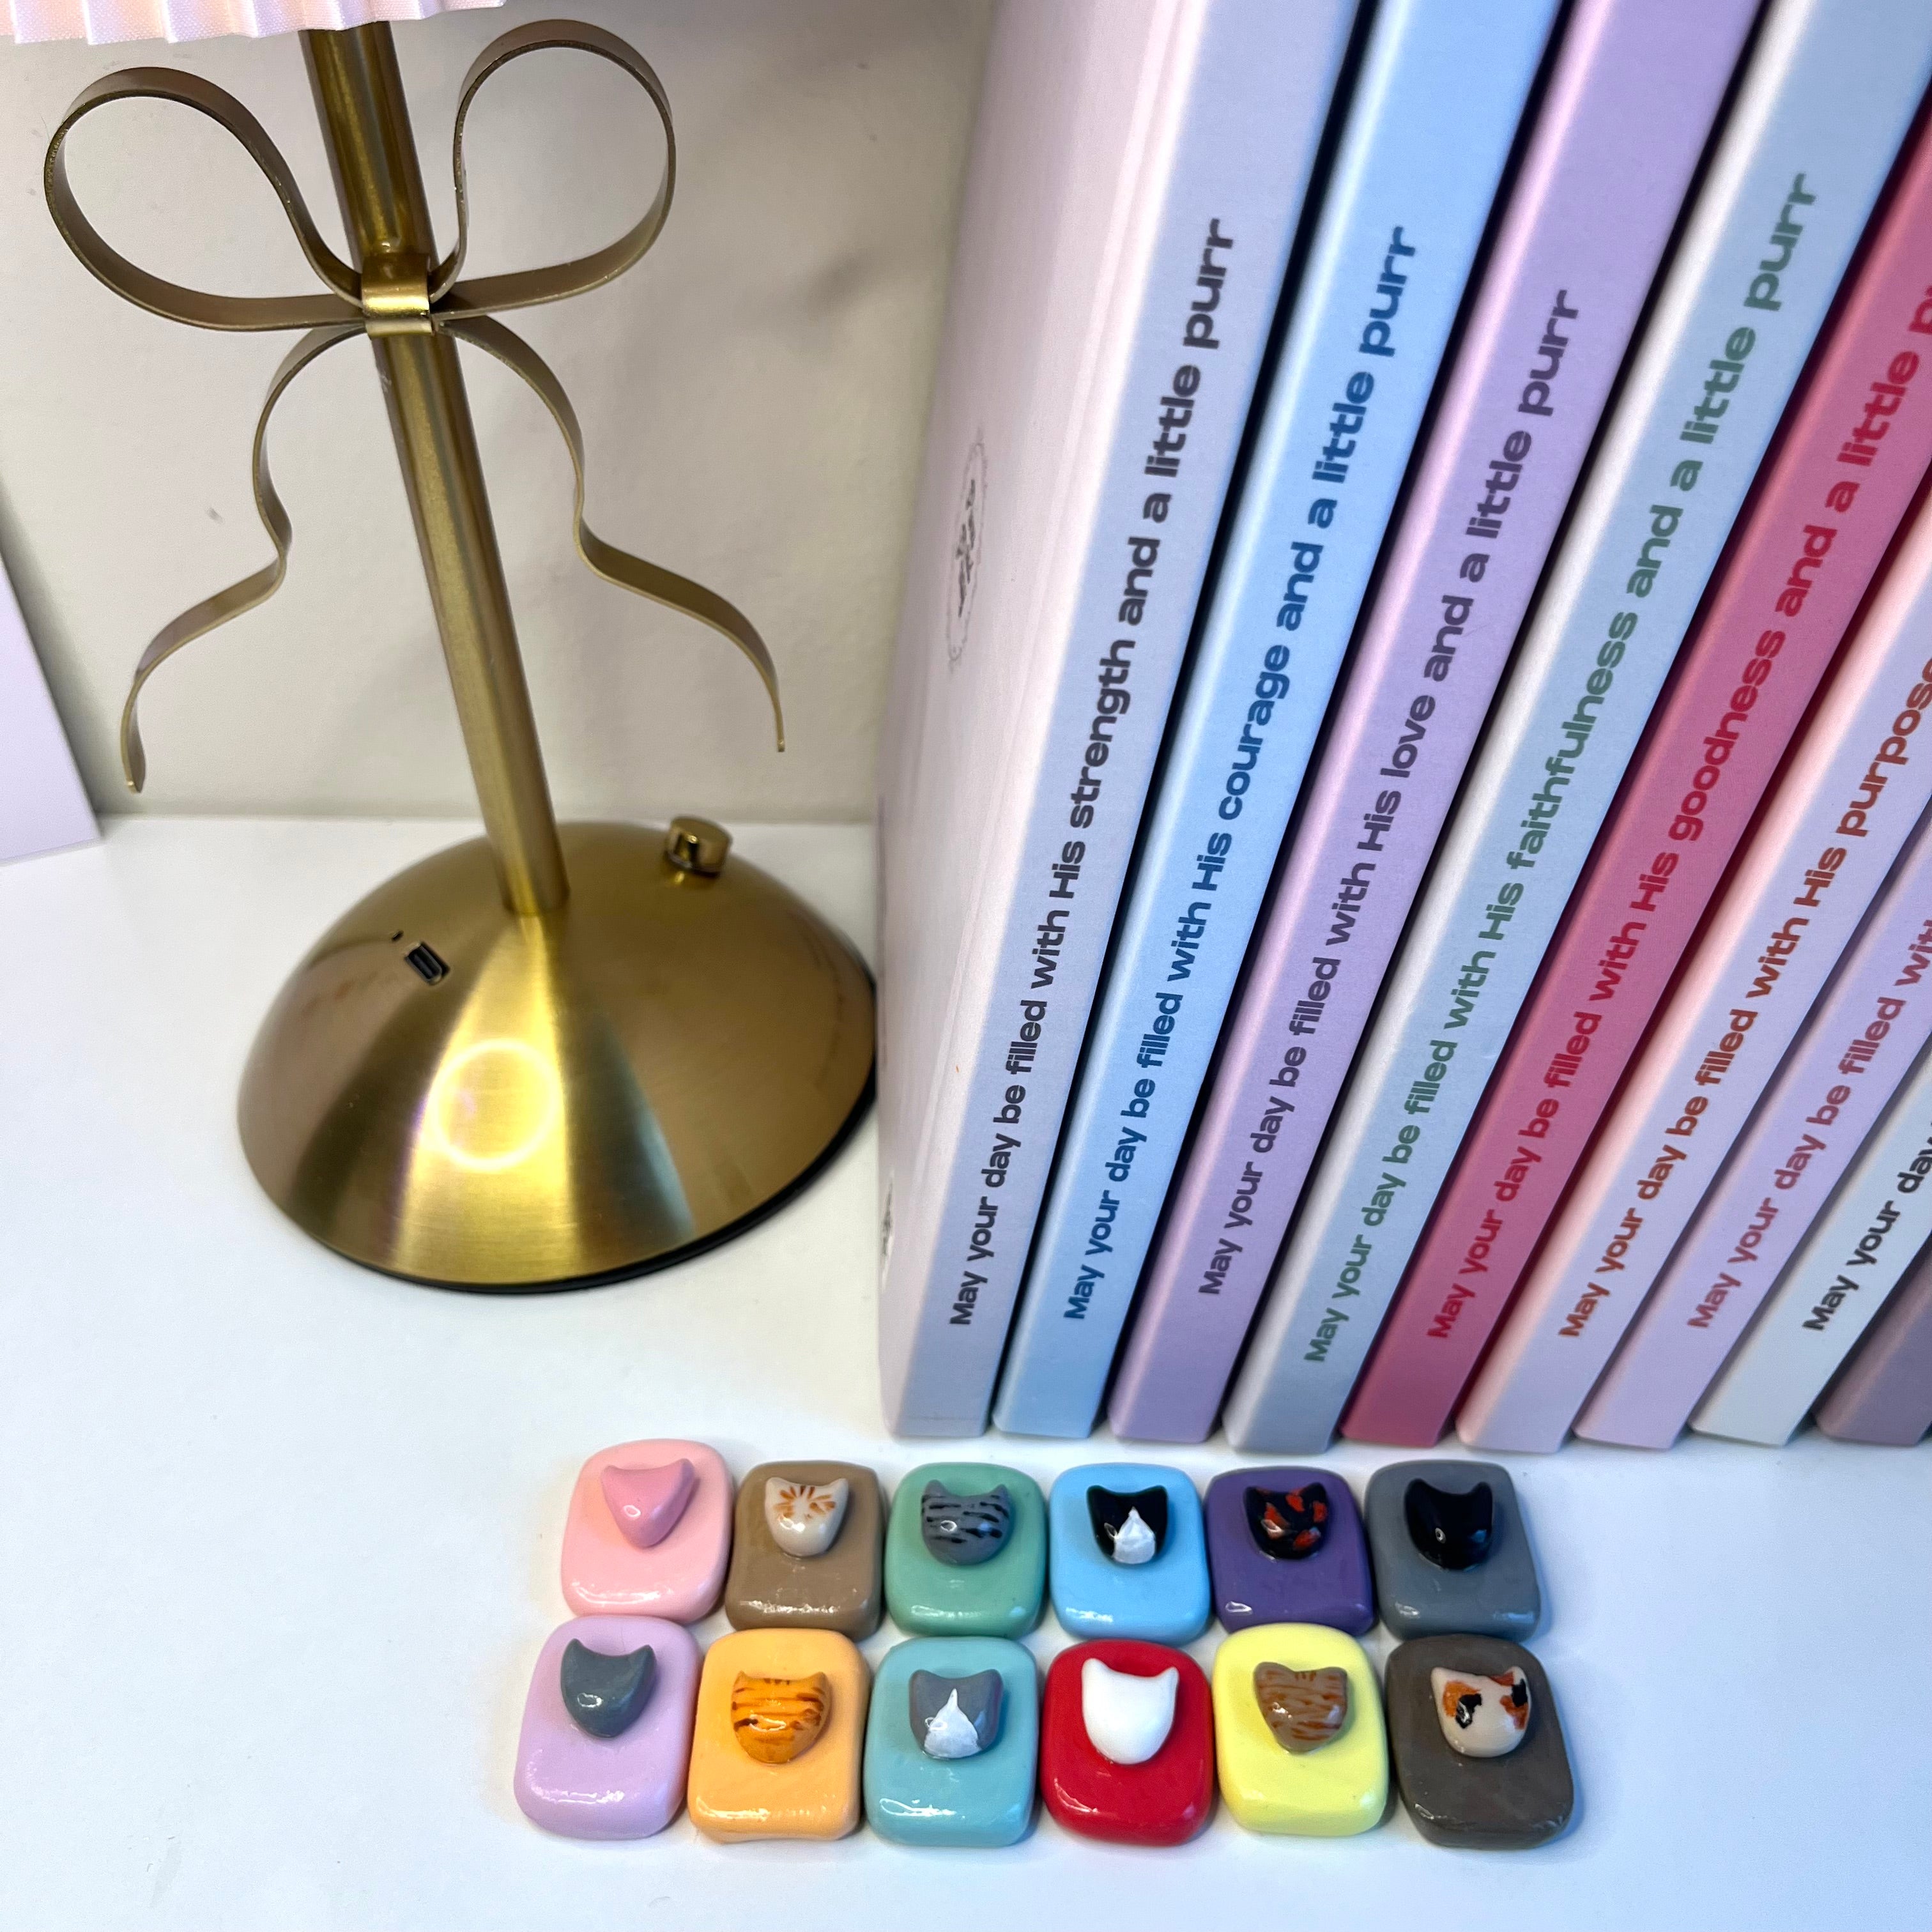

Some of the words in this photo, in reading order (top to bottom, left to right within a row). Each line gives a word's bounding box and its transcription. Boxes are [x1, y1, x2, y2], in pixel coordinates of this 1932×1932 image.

[1744, 172, 1816, 312] purr
[1183, 218, 1234, 349] purr
[1358, 226, 1416, 357] purr
[1517, 289, 1579, 417] purr
[1679, 326, 1756, 445] little
[1144, 364, 1201, 478] little
[1312, 371, 1375, 484] little
[1836, 351, 1920, 467] little
[1142, 493, 1172, 523] a
[1307, 498, 1338, 529] a
[1465, 430, 1532, 539] little
[1669, 459, 1703, 492] a
[1825, 480, 1860, 513] a
[1118, 536, 1161, 626] and
[1276, 541, 1324, 631] and
[1459, 553, 1490, 583] a
[1626, 504, 1683, 598] and
[1774, 524, 1838, 617] and
[1423, 594, 1475, 682] and
[1070, 640, 1136, 829] strength
[1218, 645, 1291, 820] courage
[1379, 694, 1436, 778] love
[1506, 611, 1638, 870] faithfulness
[1668, 629, 1786, 841] goodness
[1356, 790, 1402, 852] His
[1048, 841, 1086, 899] His
[1192, 832, 1232, 891] His
[1629, 852, 1679, 912] His
[1167, 901, 1212, 982] with
[1325, 862, 1376, 946] with
[1478, 882, 1524, 940] His
[1031, 910, 1070, 989] with
[1588, 921, 1647, 1001] with
[1289, 956, 1341, 1036] filled
[1443, 951, 1496, 1030] with
[1005, 999, 1048, 1075] filled
[1136, 992, 1184, 1068] filled
[1268, 1046, 1307, 1087] be
[1544, 1011, 1602, 1089] filled
[992, 1085, 1026, 1124] be
[1120, 1078, 1156, 1118] be
[1404, 1039, 1458, 1115] filled
[1558, 1282, 1611, 1337] May
[1595, 1208, 1643, 1273] your
[1637, 1144, 1687, 1200] day
[1664, 1096, 1708, 1137] be
[1694, 1009, 1759, 1086] filled
[1745, 917, 1810, 999] with
[1793, 847, 1847, 907] His
[1105, 1126, 1147, 1182] day
[1250, 1096, 1295, 1153] day
[1381, 1124, 1420, 1164] be
[1517, 1098, 1560, 1139] be
[981, 1133, 1022, 1188] day
[1223, 1161, 1263, 1229] your
[1493, 1146, 1542, 1202] day
[1687, 1272, 1742, 1328] May
[1727, 1197, 1779, 1263] your
[1774, 1133, 1827, 1190] day
[1805, 1085, 1851, 1126] be
[1837, 997, 1906, 1075] filled
[967, 1196, 999, 1262] your
[1084, 1190, 1120, 1255] your
[1361, 1172, 1407, 1227] day
[1802, 1275, 1860, 1331] May
[1846, 1200, 1901, 1266] your
[1897, 1137, 1932, 1193] da
[1198, 1238, 1243, 1295] May
[1331, 1234, 1372, 1299] your
[1458, 1209, 1503, 1275] your
[949, 1271, 988, 1325] May
[1063, 1264, 1105, 1320] May
[1426, 1283, 1476, 1339] May
[1303, 1307, 1349, 1363] May
